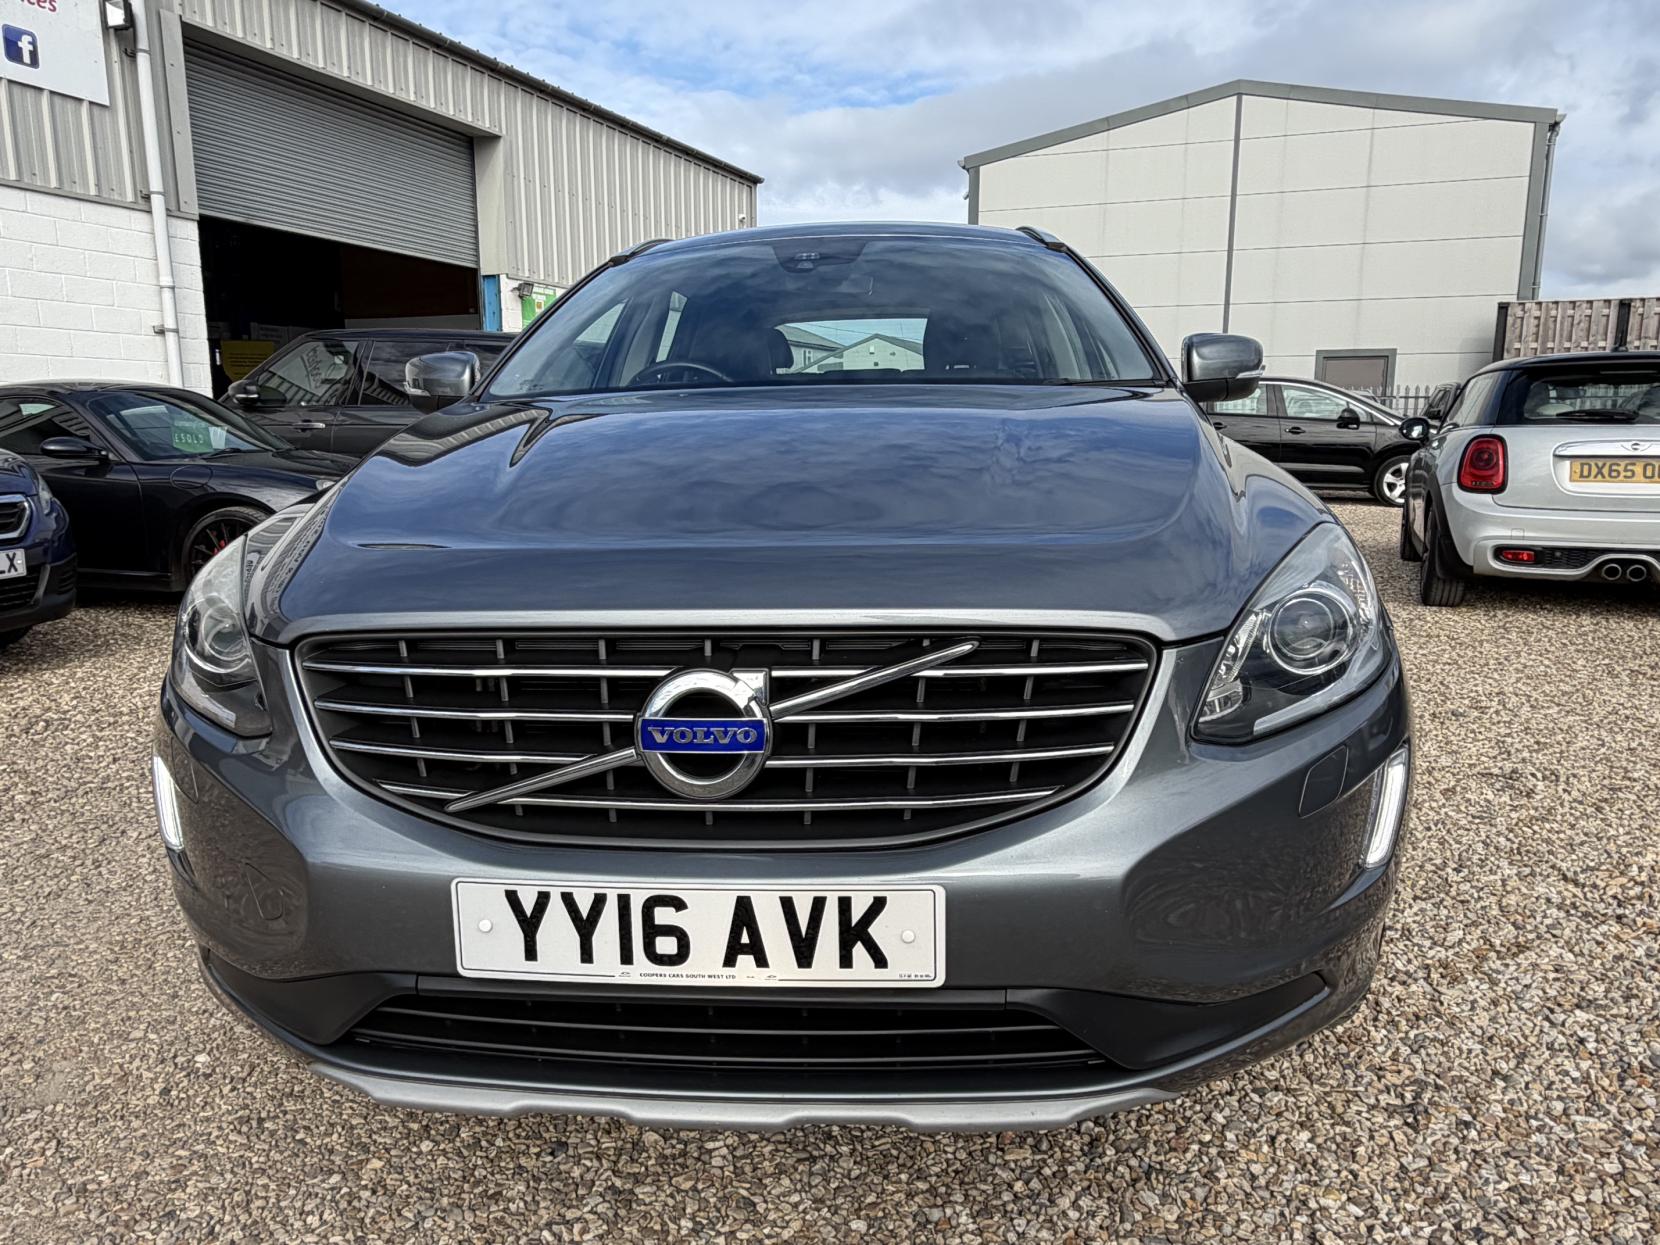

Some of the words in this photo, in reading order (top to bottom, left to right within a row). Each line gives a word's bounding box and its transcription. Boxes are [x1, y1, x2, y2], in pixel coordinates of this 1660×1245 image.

[1579, 462, 1636, 479] DX65
[1642, 462, 1660, 479] O
[647, 727, 758, 744] VOLVO
[504, 889, 691, 967] YY16
[722, 895, 889, 969] AVK
